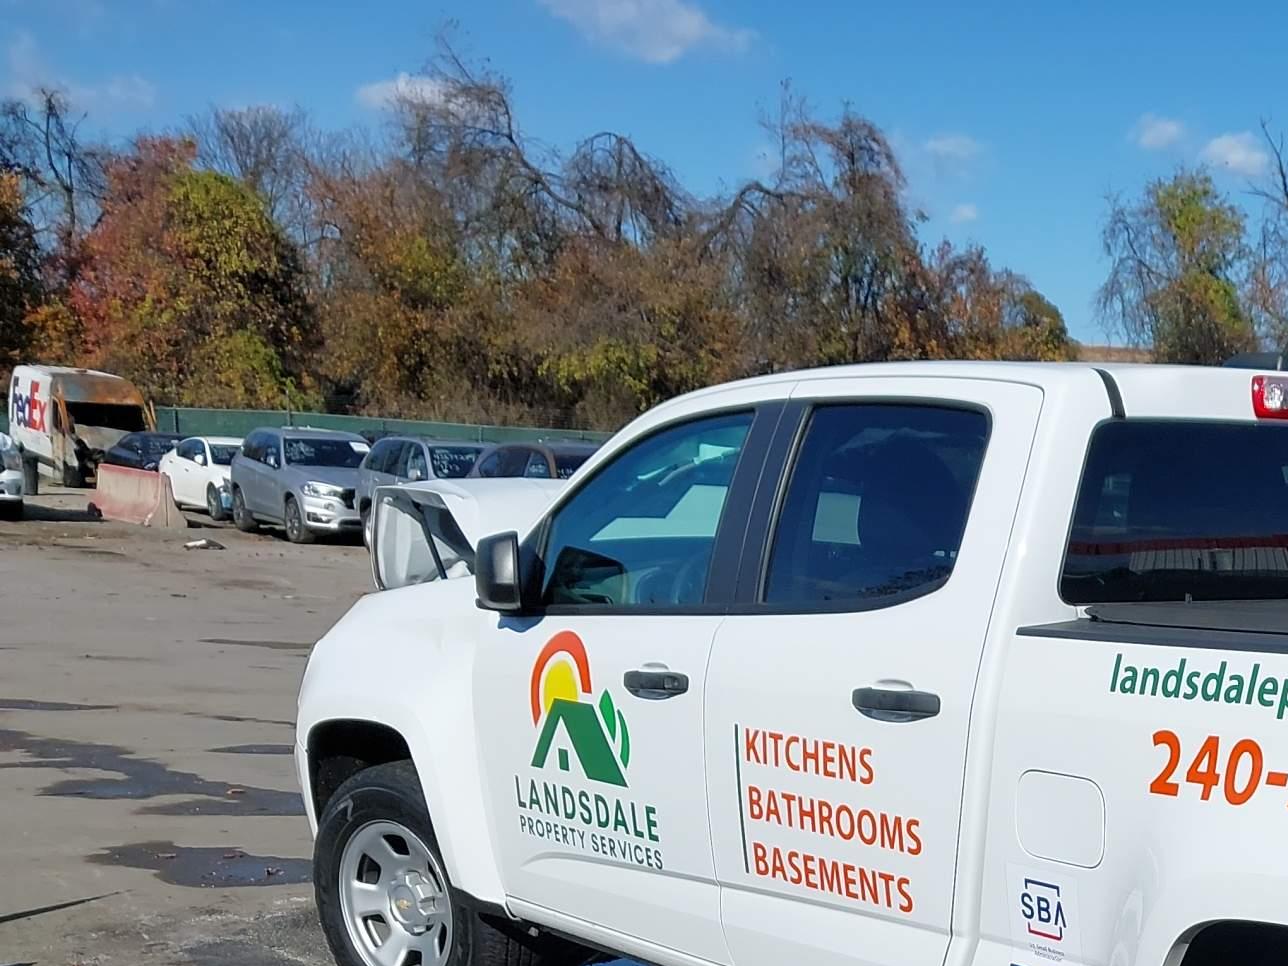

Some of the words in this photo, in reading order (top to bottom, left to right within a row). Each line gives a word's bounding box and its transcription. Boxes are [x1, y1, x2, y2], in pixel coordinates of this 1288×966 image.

[11, 376, 47, 432] FedEx
[744, 727, 875, 785] KITCHENS
[514, 775, 660, 842] LANDSDALE
[748, 786, 923, 856] BATHROOMS
[519, 815, 585, 849] PROPERTY
[591, 834, 664, 870] SERVICES
[752, 842, 914, 913] BASEMENTS
[1020, 892, 1067, 928] SBA
